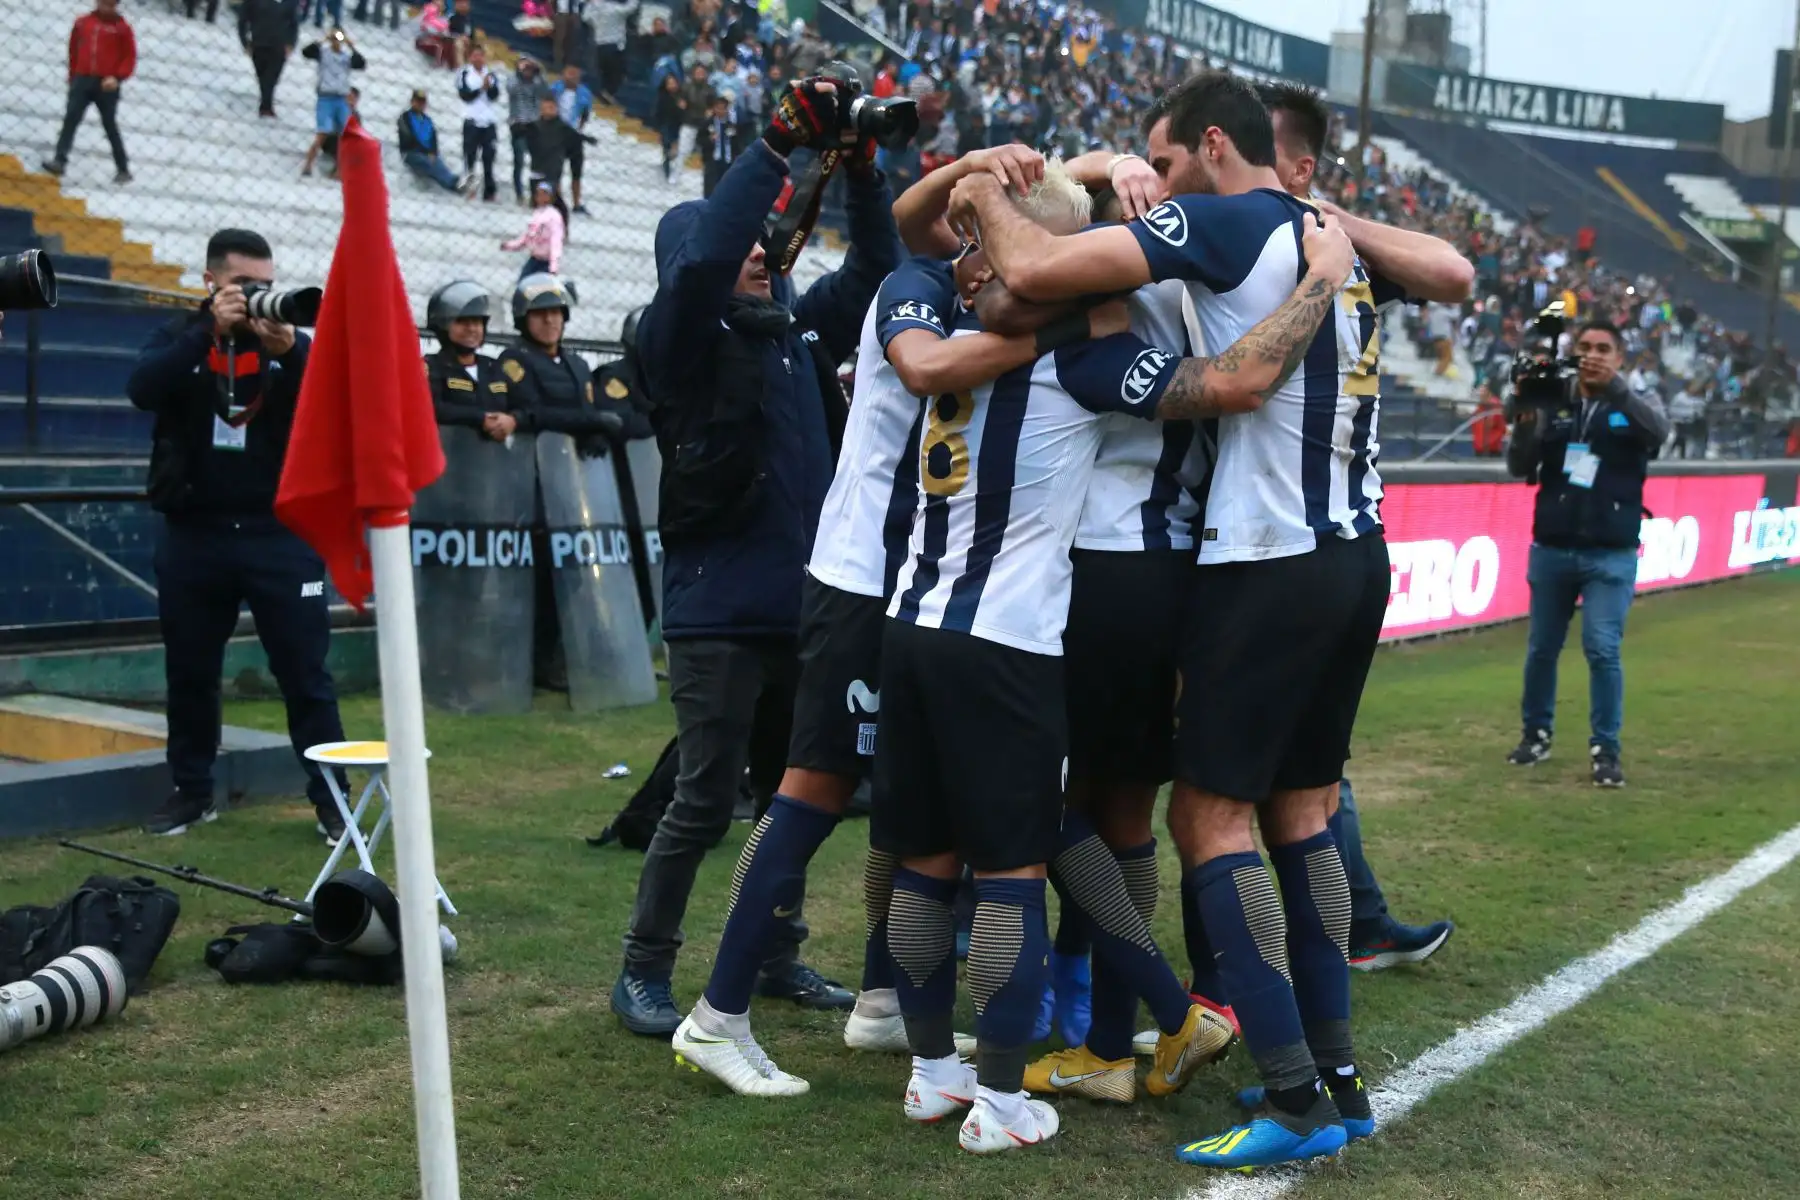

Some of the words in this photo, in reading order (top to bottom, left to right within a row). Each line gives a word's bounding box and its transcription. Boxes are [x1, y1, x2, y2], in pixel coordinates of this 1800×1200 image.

[1234, 22, 1284, 73] LIMA
[1434, 75, 1549, 123] ALIANZA
[1555, 91, 1626, 131] LIMA
[920, 387, 976, 497] 8
[411, 528, 535, 568] POLICIA
[301, 581, 324, 598] NIKE
